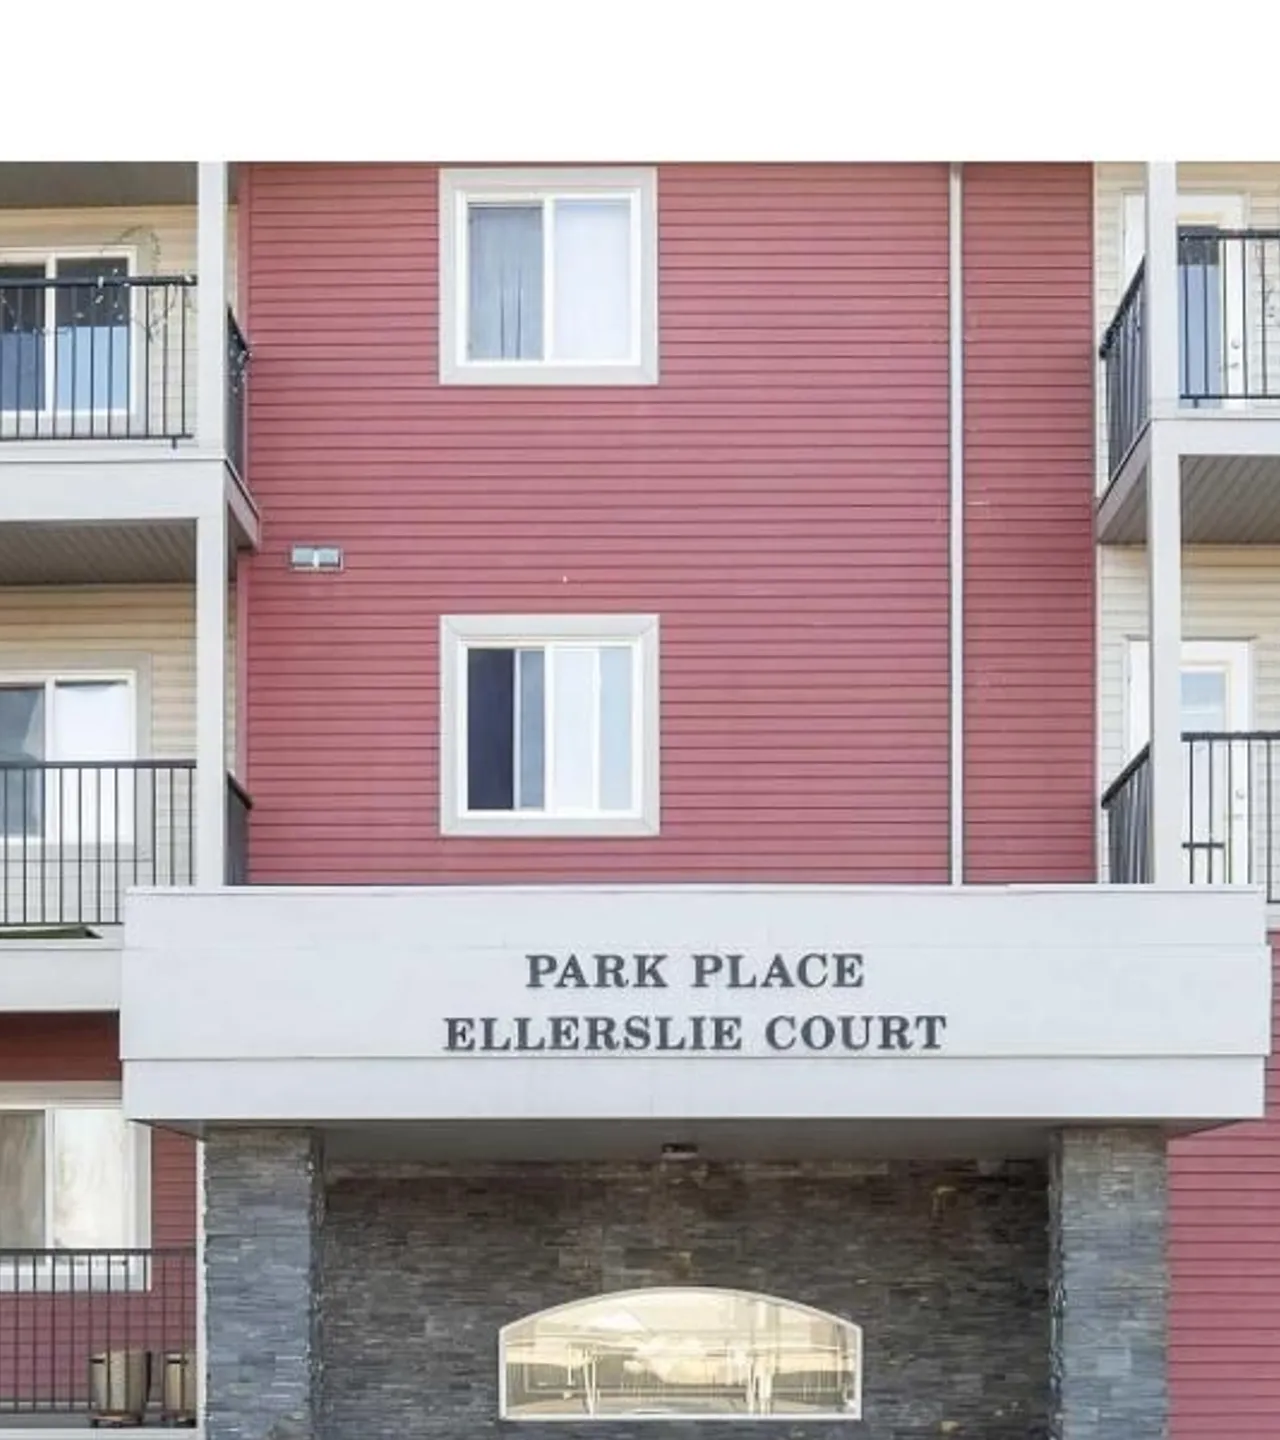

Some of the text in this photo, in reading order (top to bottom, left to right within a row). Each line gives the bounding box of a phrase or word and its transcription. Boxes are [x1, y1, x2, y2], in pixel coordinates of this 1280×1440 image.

[525, 953, 866, 989] PARK PLACE
[443, 1015, 948, 1052] ELLERSLIE COURT
